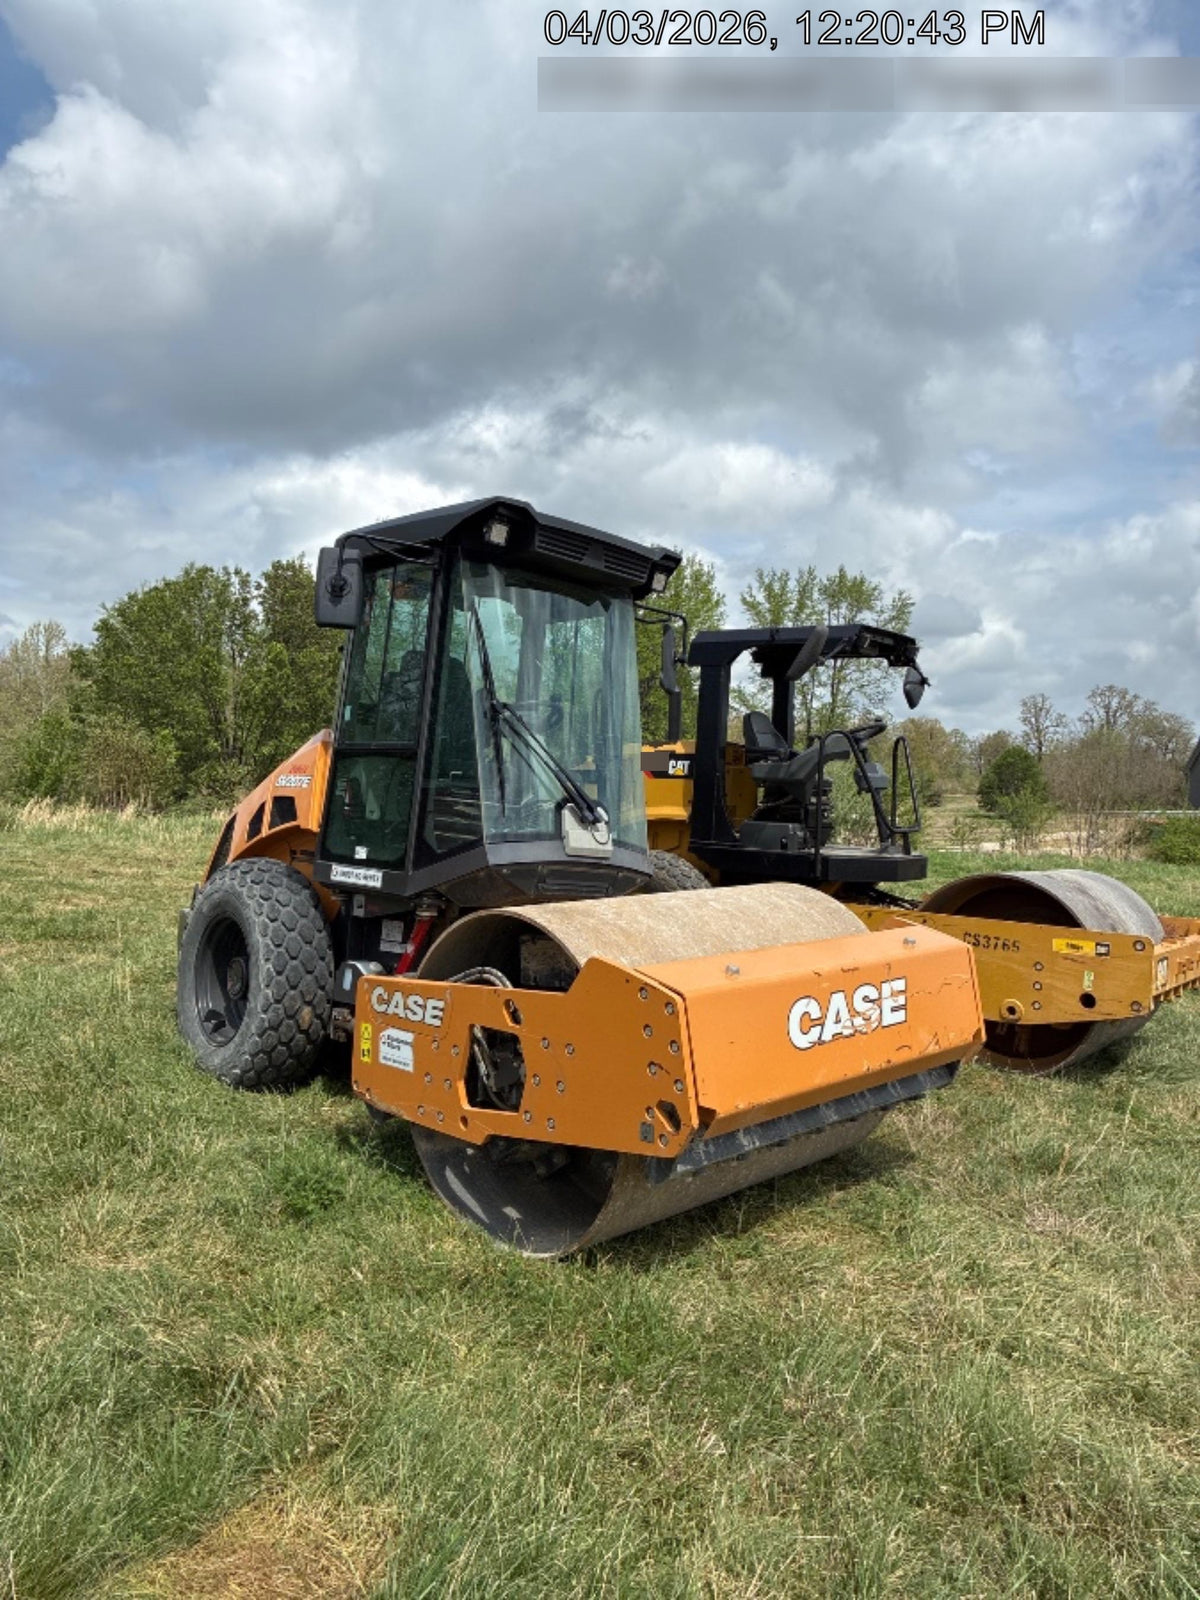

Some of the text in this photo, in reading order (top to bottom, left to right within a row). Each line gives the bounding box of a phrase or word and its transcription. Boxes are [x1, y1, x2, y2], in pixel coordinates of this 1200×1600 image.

[668, 759, 691, 775] CAT
[962, 931, 1020, 953] CS3765
[370, 985, 445, 1027] CASE
[788, 976, 907, 1051] CASE
